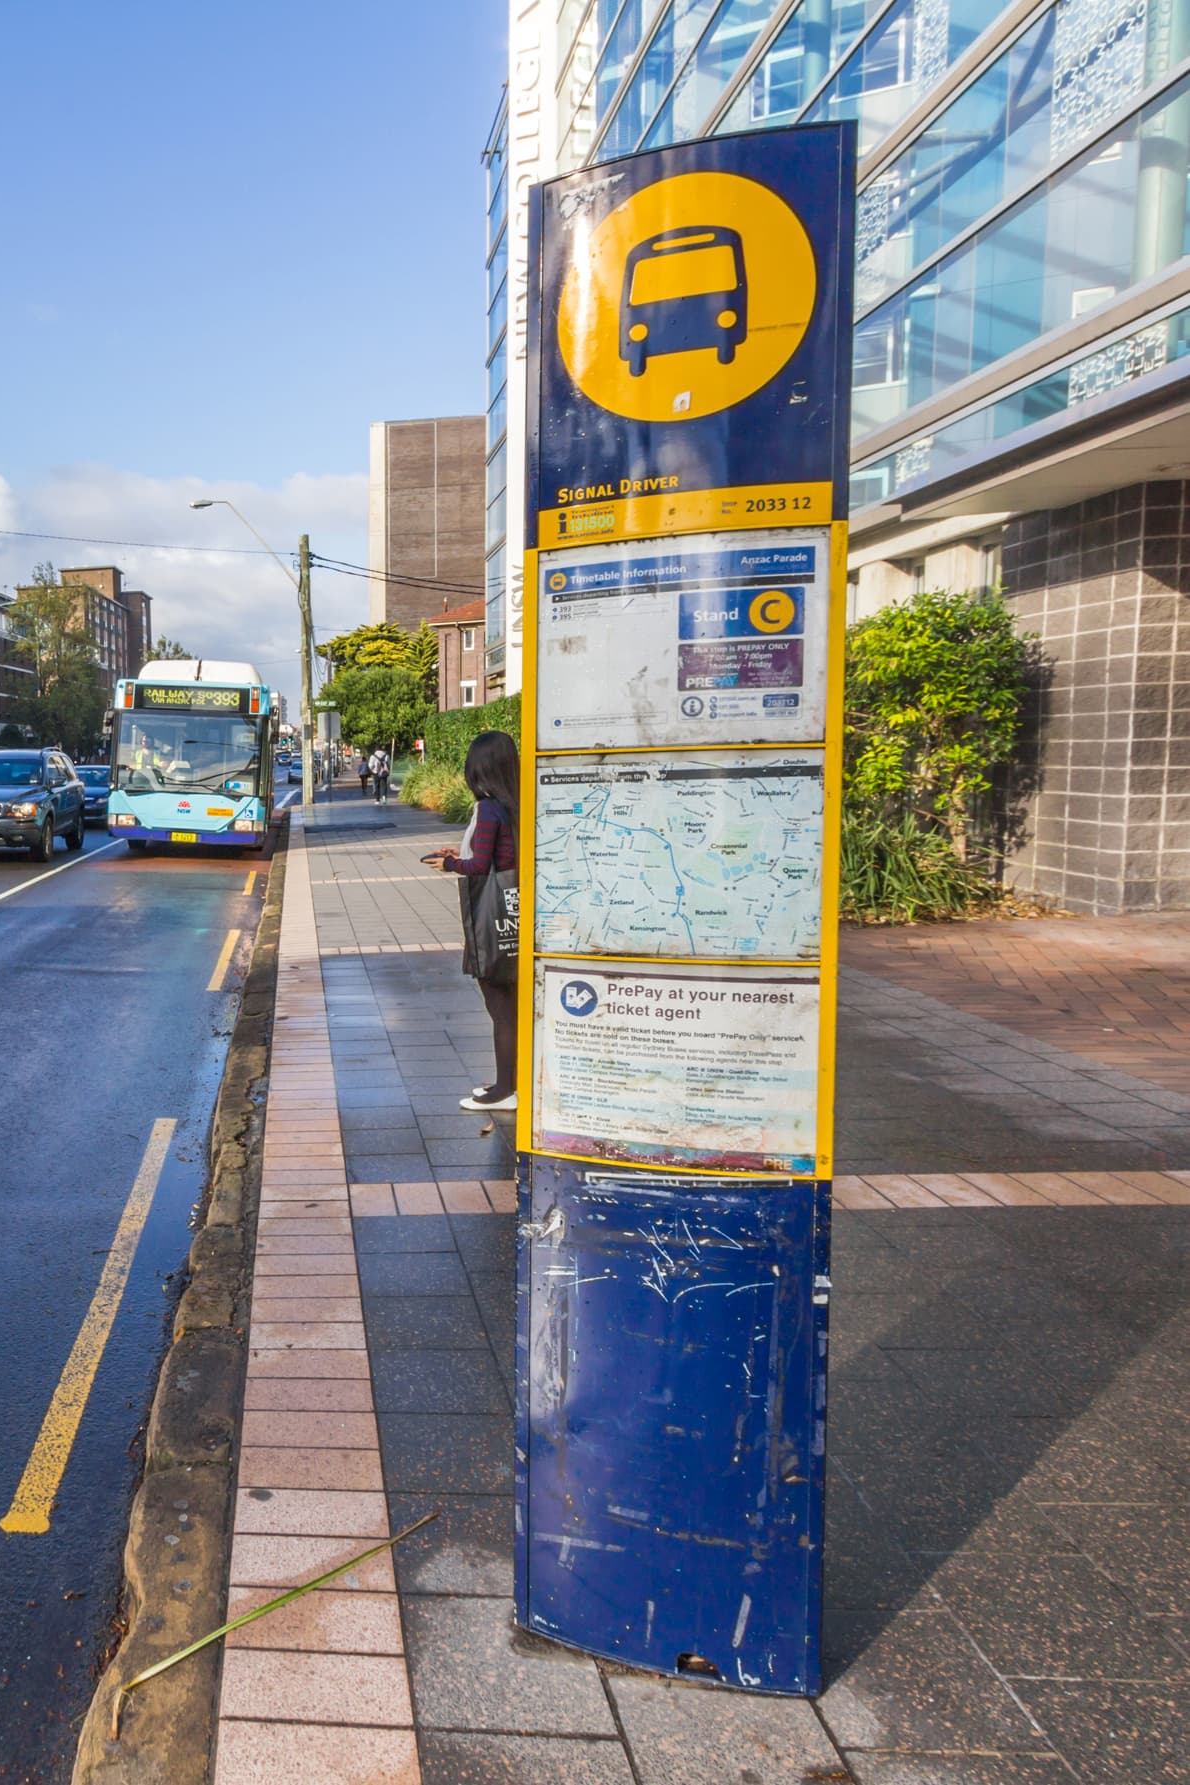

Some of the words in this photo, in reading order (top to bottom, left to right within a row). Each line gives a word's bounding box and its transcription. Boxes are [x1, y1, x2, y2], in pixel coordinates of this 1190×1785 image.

[557, 486, 615, 503] SIGNAL
[619, 476, 679, 496] DRIVER
[745, 498, 787, 513] 2033
[792, 497, 811, 511] 12
[740, 555, 771, 565] Anzac
[773, 553, 808, 563] Parade
[570, 571, 620, 585] Timetable
[623, 565, 687, 578] Information
[693, 607, 739, 623] Stand
[760, 599, 781, 624] C
[143, 688, 194, 697] RAILWAY
[213, 692, 240, 706] 393
[495, 918, 519, 932] UN
[607, 983, 663, 1001] PrePay
[668, 988, 683, 1000] at
[689, 991, 727, 1003] your
[732, 992, 795, 1004] nearest
[607, 1003, 649, 1017] ticket
[655, 1007, 701, 1021] agent
[566, 1029, 588, 1037] tickets
[588, 1023, 604, 1031] have
